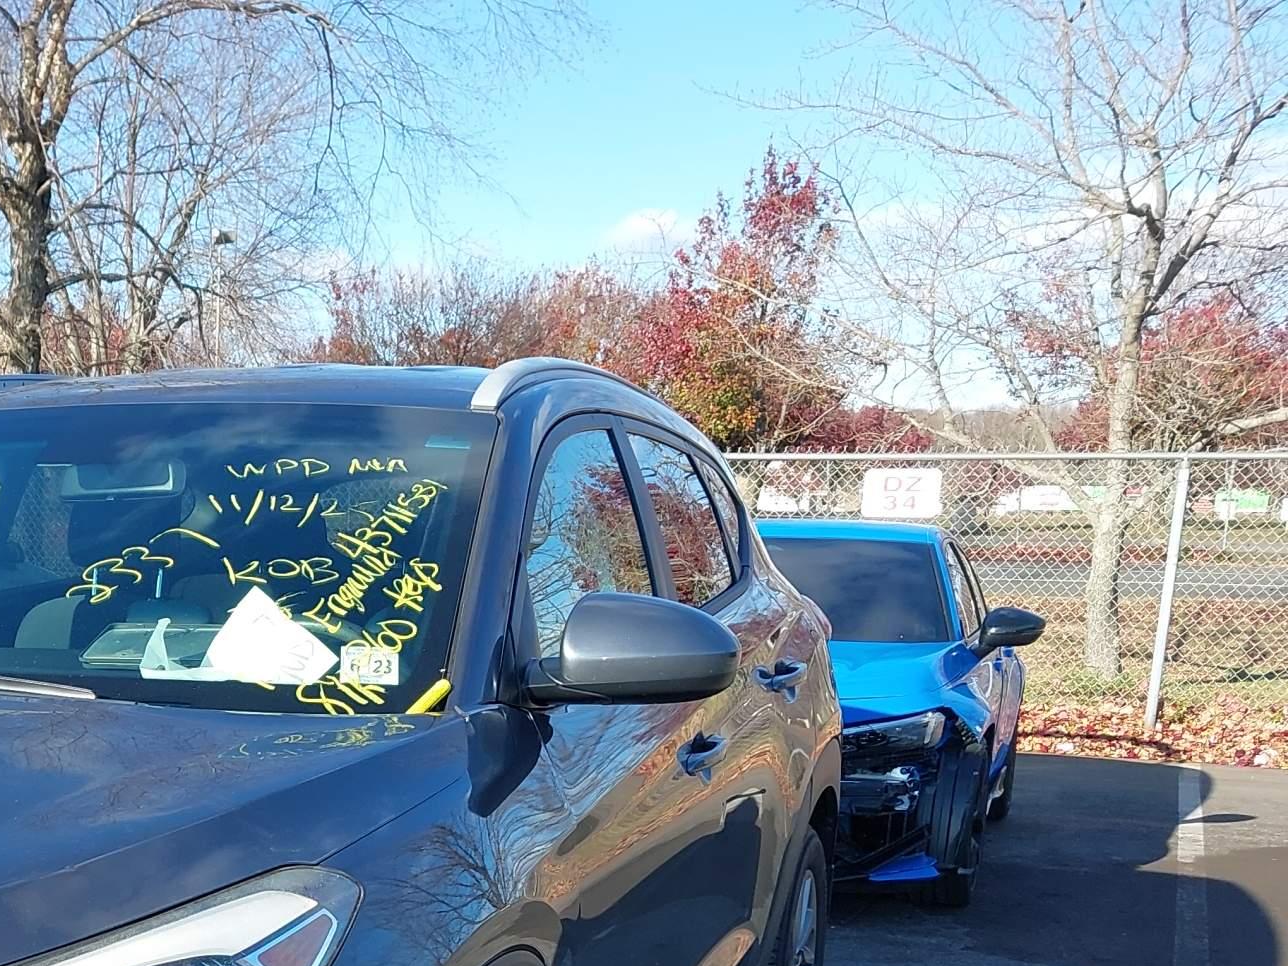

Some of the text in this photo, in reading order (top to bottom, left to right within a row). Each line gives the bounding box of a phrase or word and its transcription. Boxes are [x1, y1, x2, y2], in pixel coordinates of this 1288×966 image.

[883, 476, 922, 492] DZ
[883, 495, 916, 511] 34
[372, 659, 394, 674] 23
